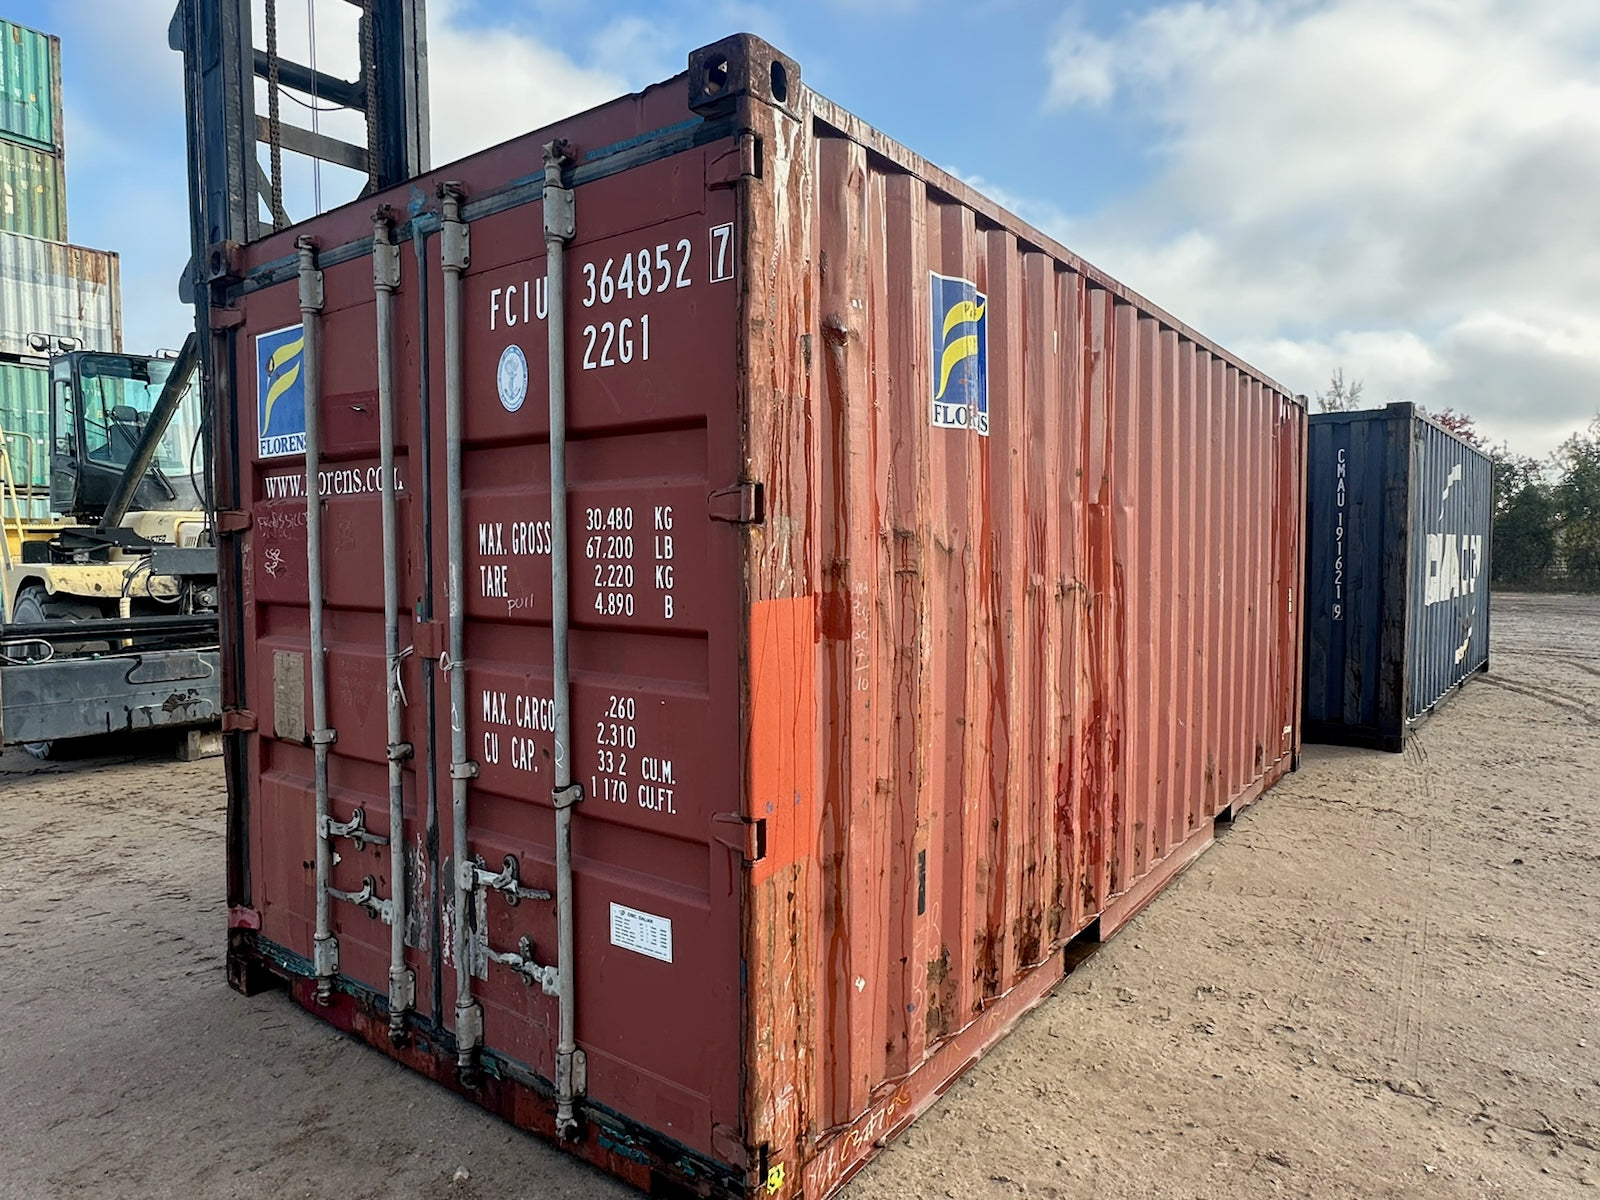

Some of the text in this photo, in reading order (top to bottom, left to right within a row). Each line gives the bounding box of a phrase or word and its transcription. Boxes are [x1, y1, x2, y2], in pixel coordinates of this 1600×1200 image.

[490, 224, 732, 331] FCIU 364852 7
[582, 313, 649, 370] 22G1
[1336, 448, 1346, 507] CMAU
[478, 506, 673, 556] MAX. GROSS 30,480 KG
[586, 535, 673, 560] 67,200 LB
[1334, 512, 1344, 600] 191621
[479, 563, 674, 598] TARE 2,220 KG
[594, 592, 673, 620] 4,890 B
[482, 689, 512, 726] MAX.
[515, 694, 555, 733] CARGO
[484, 731, 499, 764] CU
[511, 735, 538, 773] CAP.
[641, 756, 677, 785] CU.M.
[596, 721, 636, 749] 2,310
[637, 784, 678, 815] CU.FT.
